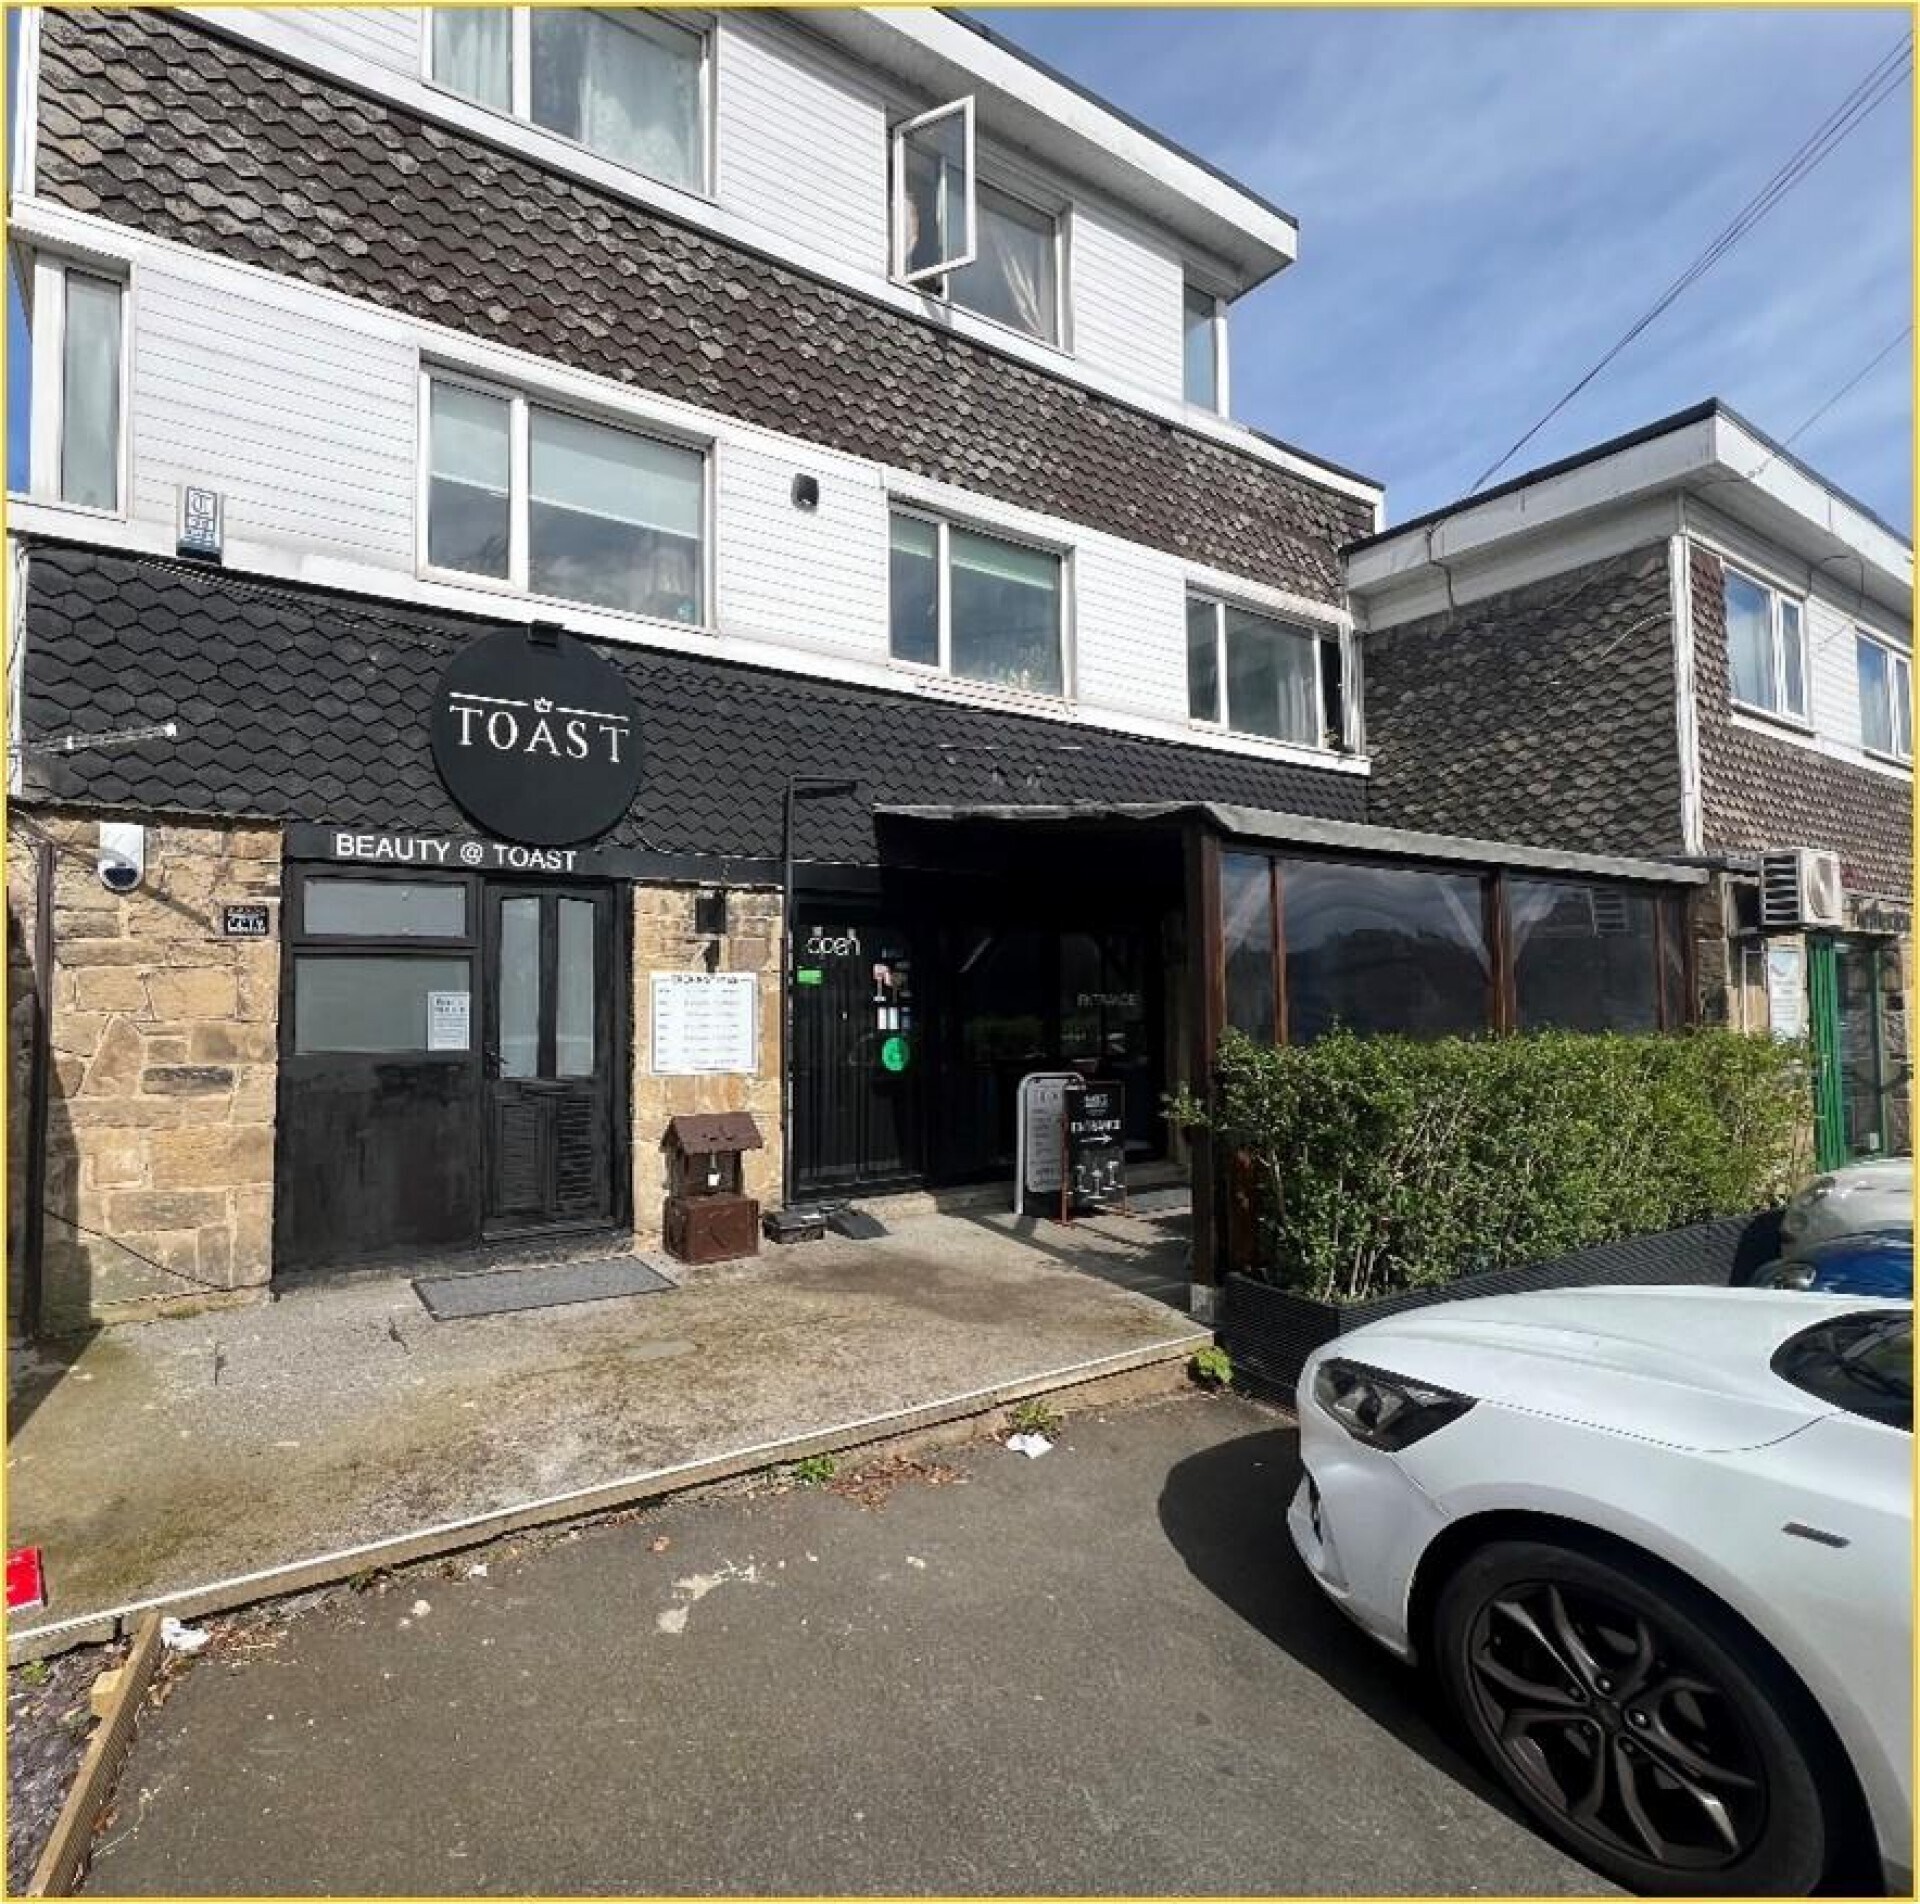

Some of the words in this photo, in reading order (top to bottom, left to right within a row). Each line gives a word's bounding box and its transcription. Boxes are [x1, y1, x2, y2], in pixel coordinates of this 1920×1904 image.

[449, 704, 630, 763] TOAST
[336, 833, 451, 863] BEAUTY
[459, 841, 484, 865] @
[493, 843, 577, 871] TOAST
